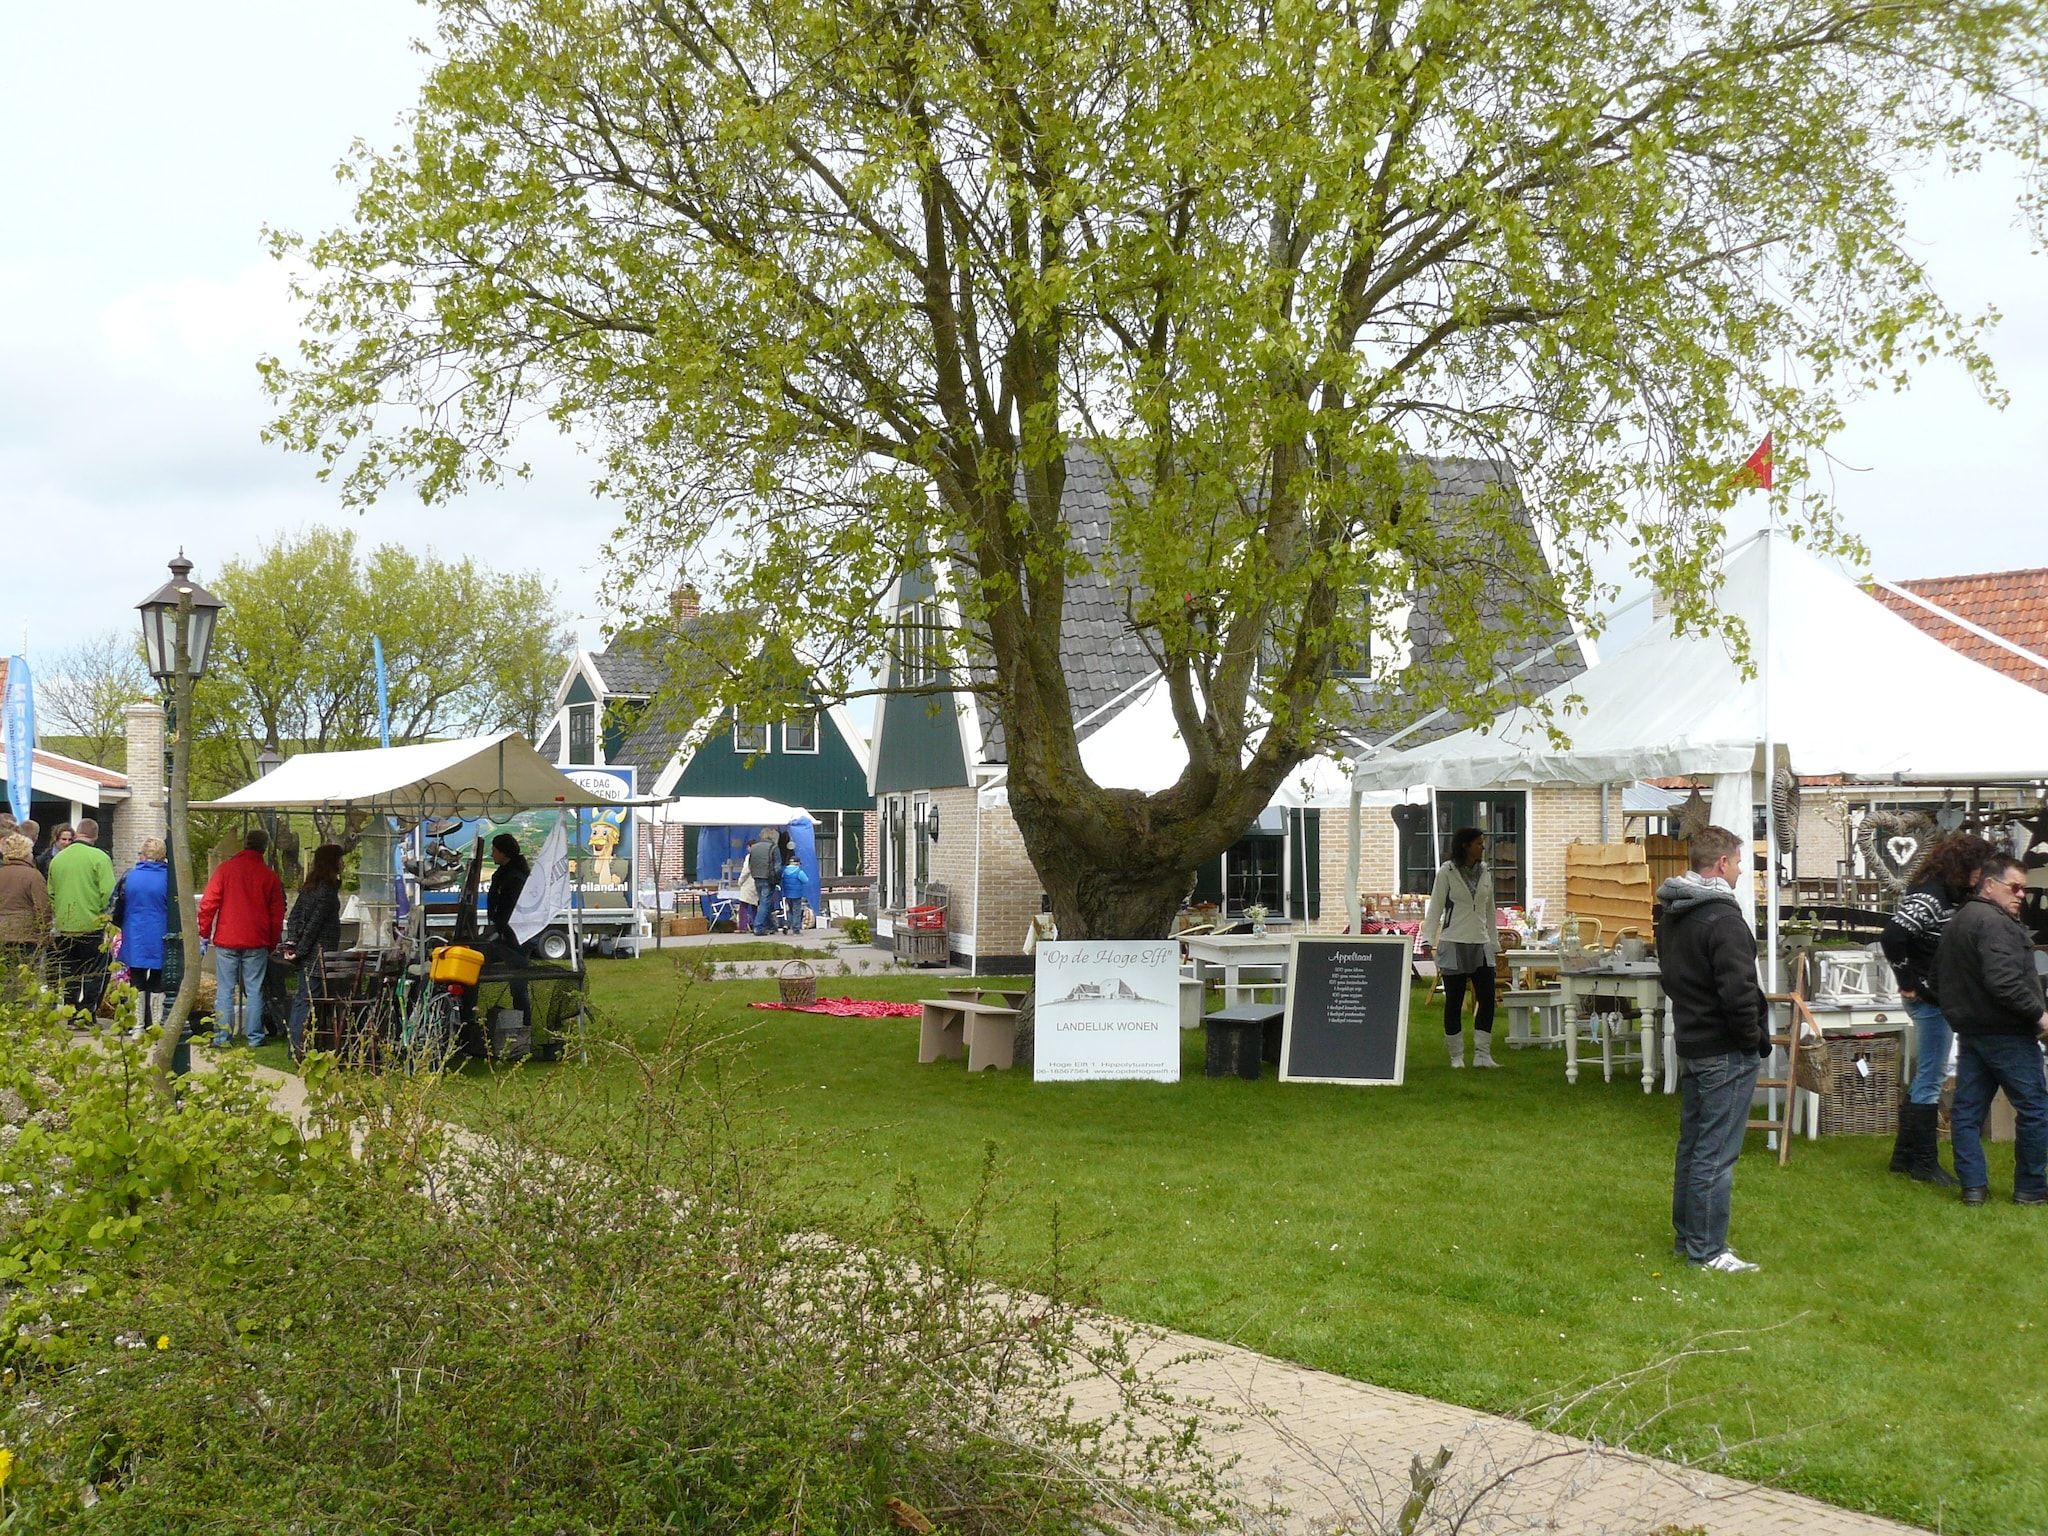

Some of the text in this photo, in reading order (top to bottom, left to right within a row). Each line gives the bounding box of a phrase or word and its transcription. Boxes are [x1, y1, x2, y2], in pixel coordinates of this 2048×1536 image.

[593, 779, 609, 788] DAG
[1071, 948, 1090, 963] de
[1092, 950, 1138, 968] Hoge
[1056, 1022, 1159, 1031] LANDELIJK WONEN
